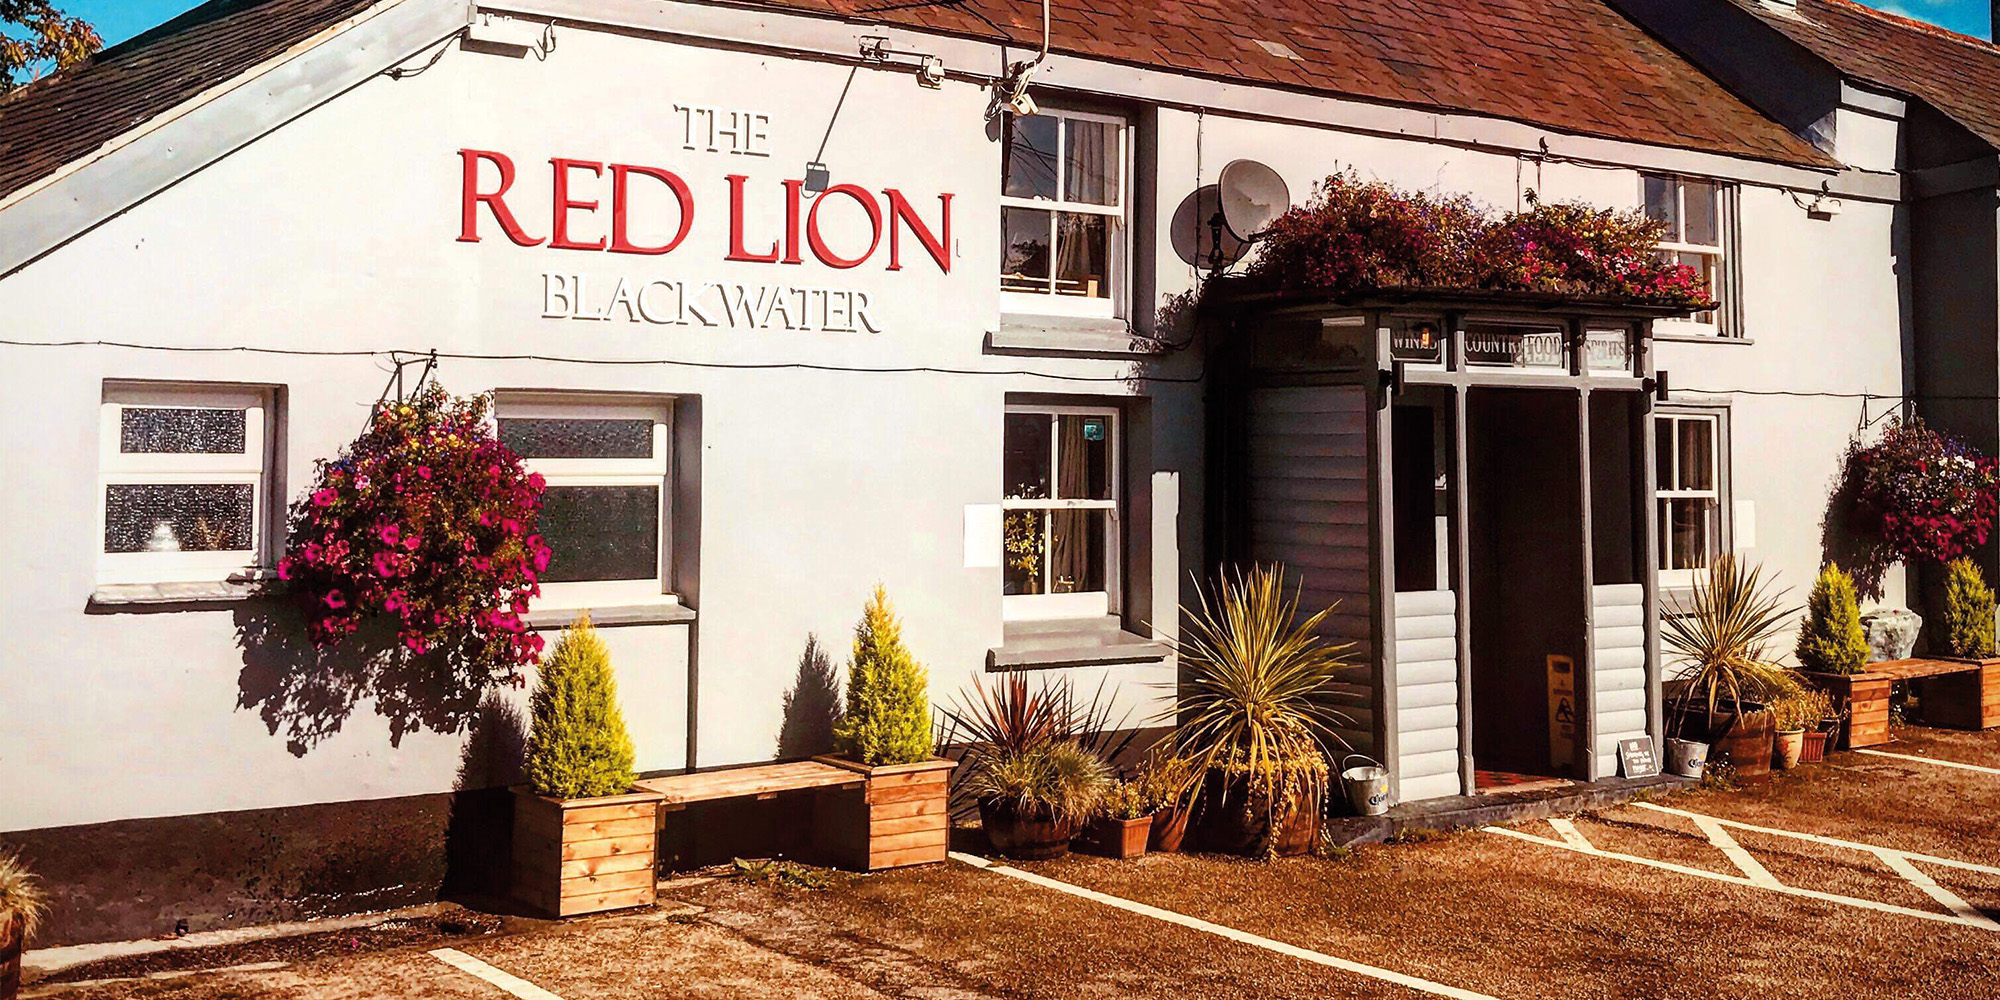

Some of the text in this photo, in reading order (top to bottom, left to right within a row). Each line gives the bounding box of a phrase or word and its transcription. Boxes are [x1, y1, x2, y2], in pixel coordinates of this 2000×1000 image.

[672, 103, 774, 158] THE
[456, 148, 956, 276] RED LION
[541, 272, 882, 334] BLACKWATER
[1525, 335, 1561, 355] FOOD
